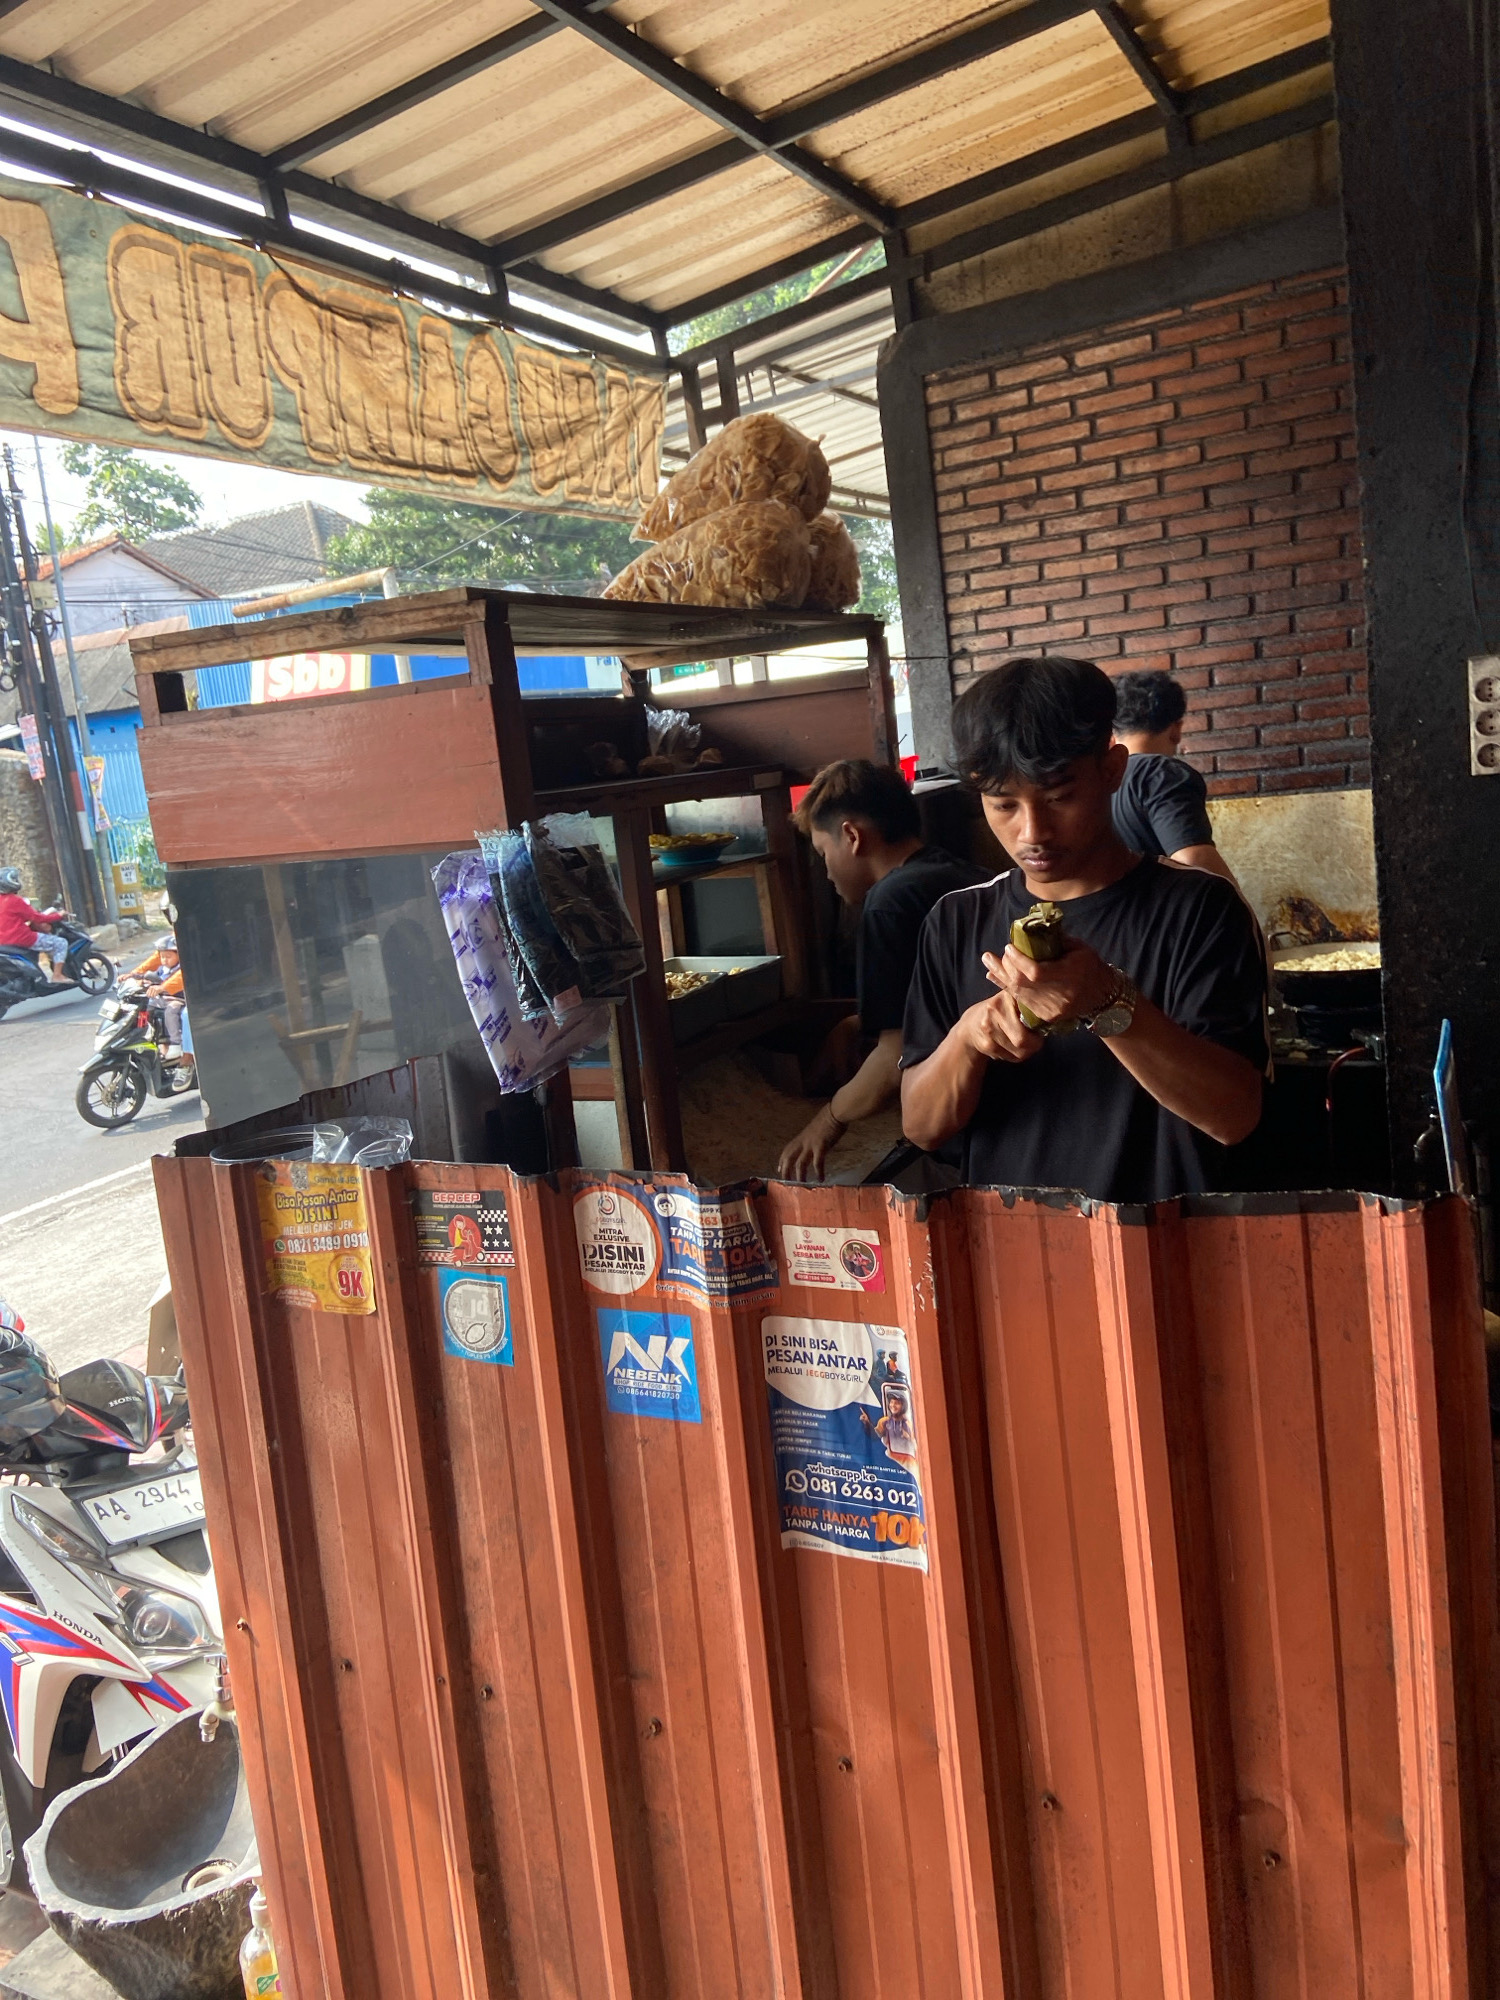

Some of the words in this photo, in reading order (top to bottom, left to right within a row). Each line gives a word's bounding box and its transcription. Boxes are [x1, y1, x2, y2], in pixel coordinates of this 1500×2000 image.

[296, 1191, 326, 1207] Pesan
[328, 1188, 358, 1203] Antar
[432, 1192, 480, 1203] GERCEP
[296, 1205, 339, 1223] DISINI
[339, 1220, 354, 1230] JEK
[593, 1234, 630, 1242] EXLUSIVE
[582, 1244, 645, 1262] DISINI
[795, 1243, 825, 1252] LAYANAN
[585, 1260, 614, 1268] PESAN
[615, 1262, 646, 1271] ANTAR
[337, 1270, 366, 1298] 9K
[765, 1335, 778, 1347] DI
[781, 1336, 806, 1348] SINI
[809, 1338, 838, 1351] BISA
[766, 1349, 814, 1365] PESAN
[817, 1354, 869, 1371] ANTAR
[613, 1367, 683, 1385] NEBENK
[767, 1367, 803, 1376] MELALUI
[808, 1463, 861, 1483] whatsapp
[862, 1469, 878, 1482] ke
[93, 1497, 127, 1520] AA
[135, 1479, 190, 1508] 2944
[810, 1477, 837, 1495] 081
[841, 1483, 884, 1502] 6263
[887, 1489, 917, 1507] 012
[783, 1505, 819, 1519] TARIF
[823, 1509, 870, 1529] HANYA
[785, 1517, 819, 1531] TANPA
[820, 1522, 832, 1533] UP
[835, 1525, 871, 1540] HARGA
[53, 1610, 104, 1646] HONDA
